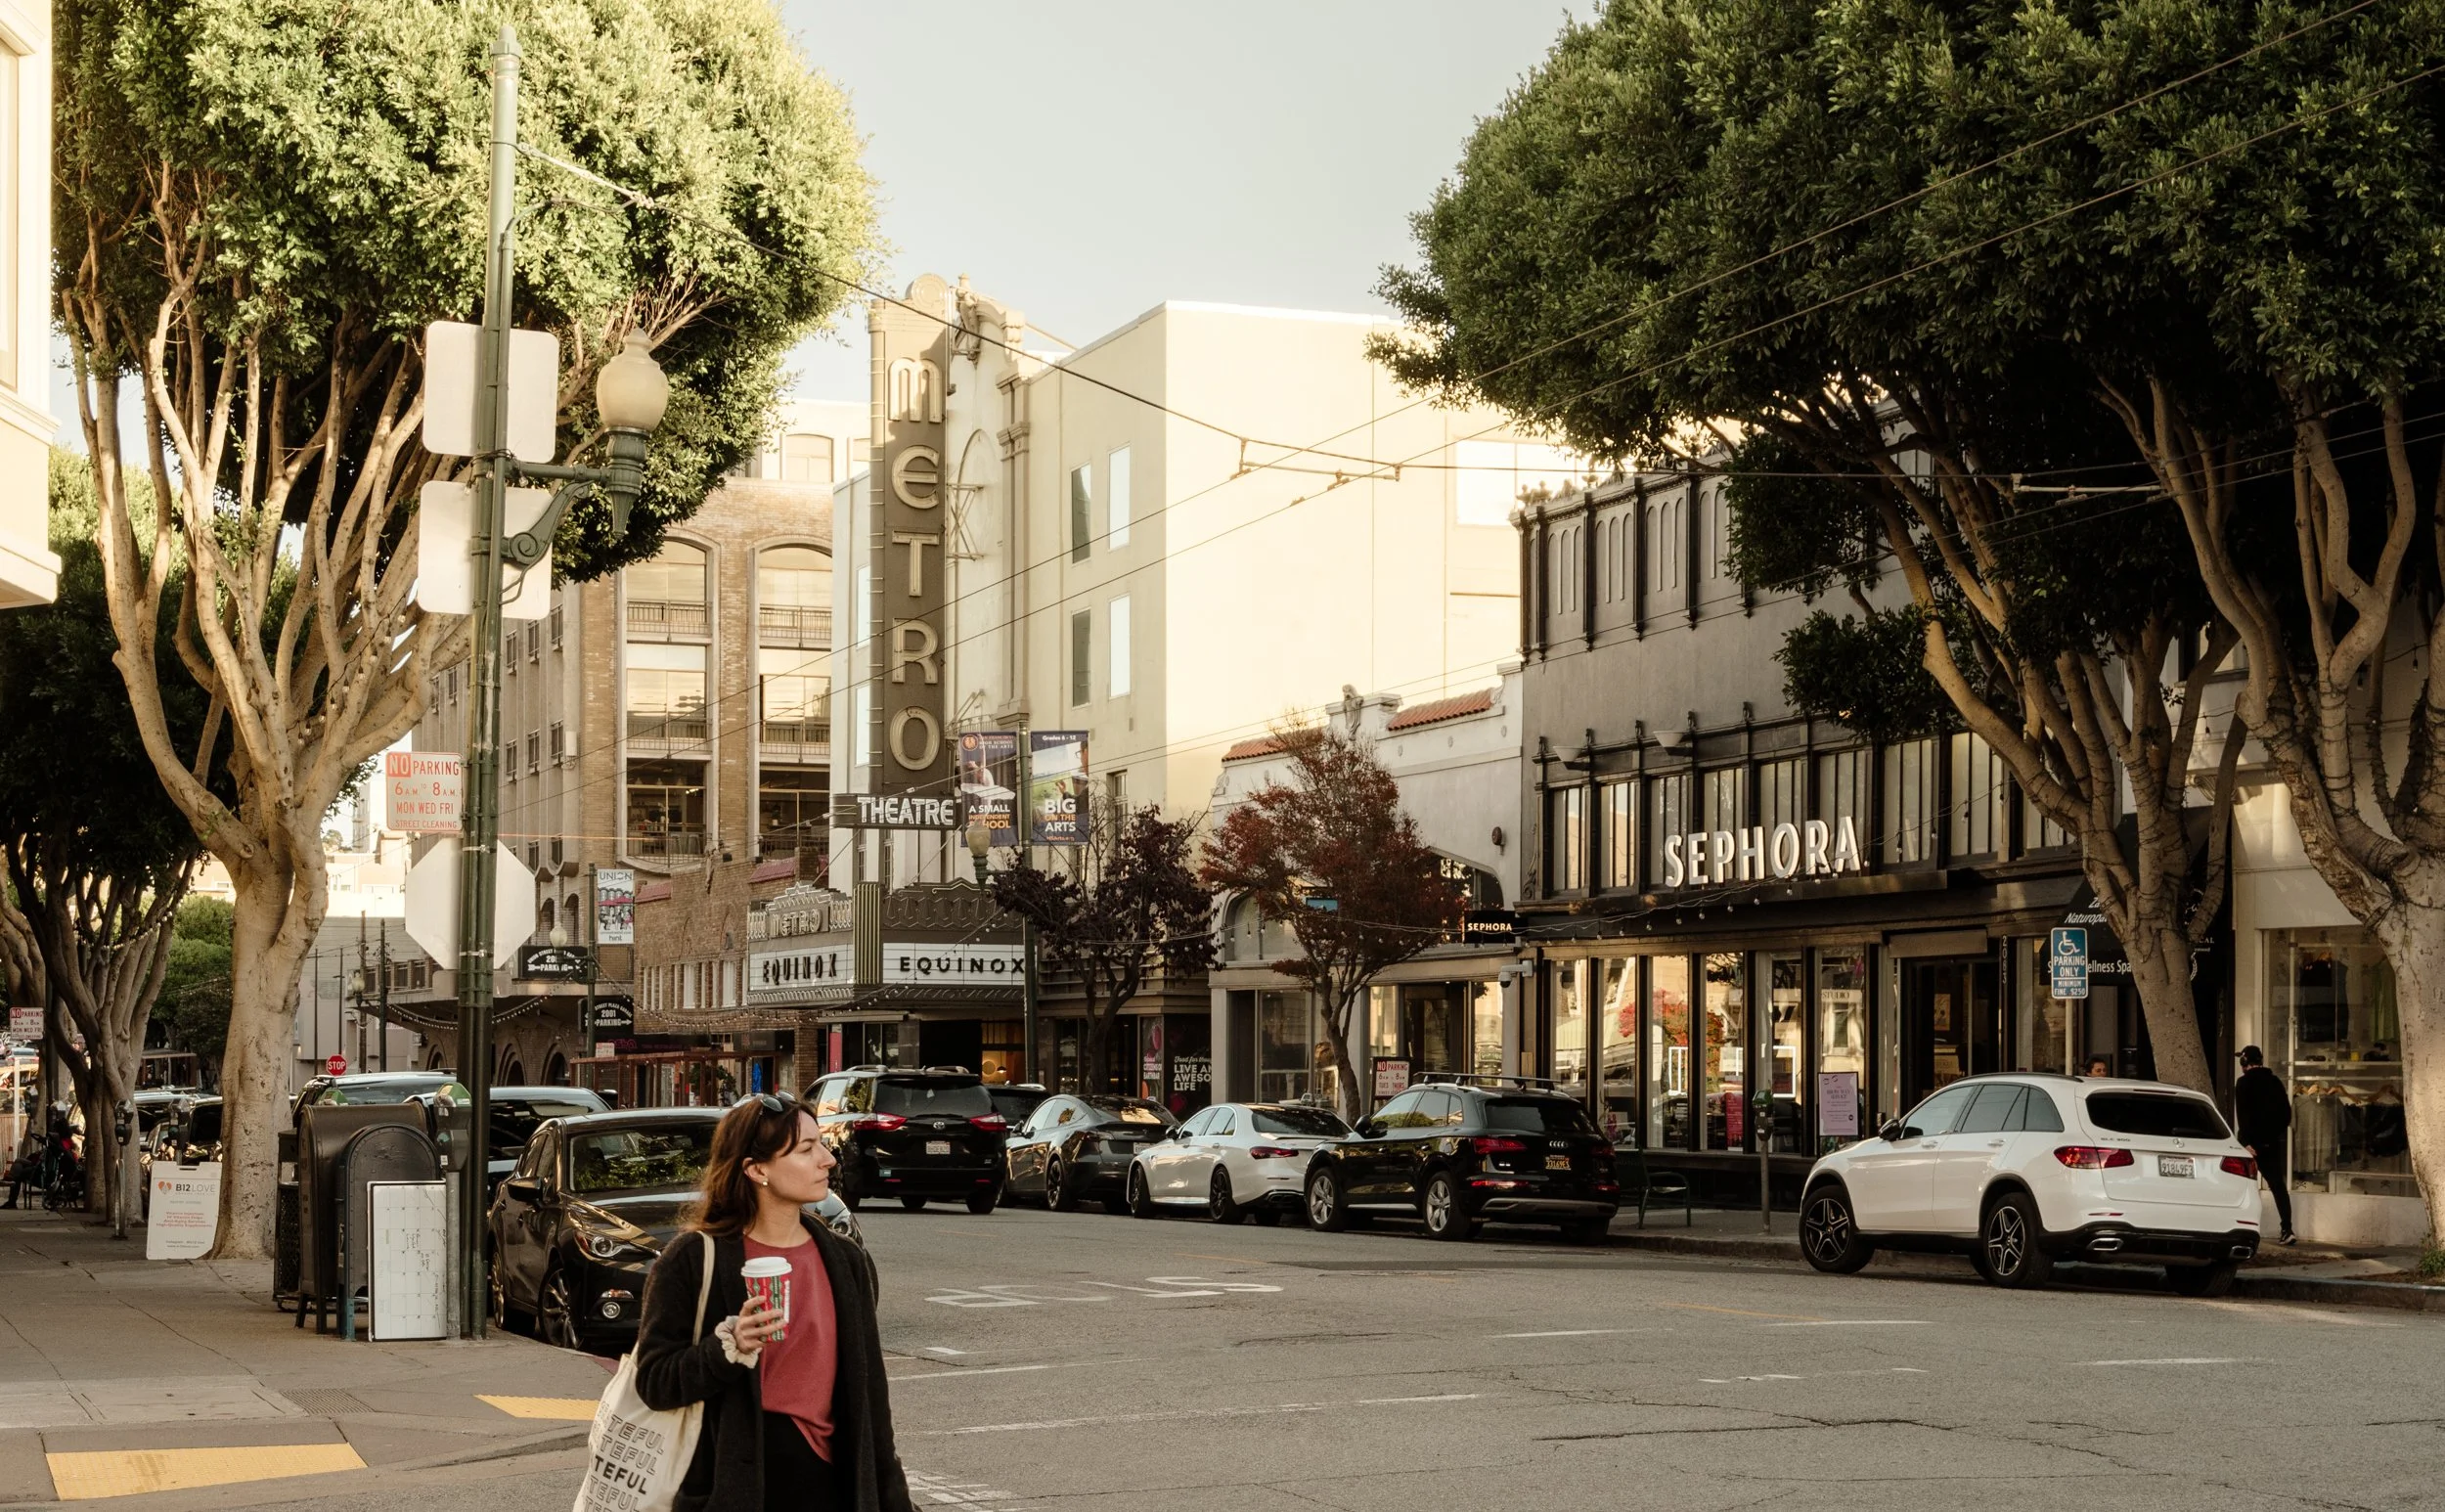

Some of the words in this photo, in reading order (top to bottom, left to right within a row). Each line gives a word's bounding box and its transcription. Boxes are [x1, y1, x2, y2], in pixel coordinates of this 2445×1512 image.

[389, 754, 410, 775] NO
[413, 761, 460, 776] PARKING
[396, 802, 415, 814] MON
[419, 802, 436, 815] WED
[439, 803, 454, 814] FRI
[858, 796, 955, 825] THEATRE
[978, 804, 1011, 813] SMALL
[1045, 798, 1077, 814] BIG
[1045, 822, 1077, 832] ARTS
[1665, 816, 1861, 887] SEPHORA
[600, 871, 633, 880] UNION
[770, 909, 822, 936] METRO
[1467, 922, 1512, 931] SEPHORA
[900, 956, 1025, 975] EQUINOX
[2054, 956, 2085, 966] PARKING
[763, 954, 837, 986] EQUINOX
[2060, 967, 2079, 977] ONLY
[2088, 959, 2114, 973] ellness
[2116, 959, 2132, 975] Spa
[11, 1008, 21, 1017] NO
[600, 1009, 616, 1018] 2001
[596, 1018, 622, 1027] PARKING
[328, 1061, 345, 1070] STOP
[1174, 1064, 1197, 1073] LIVE
[1377, 1061, 1386, 1071] NO
[1174, 1073, 1212, 1083] AWESO
[1174, 1082, 1196, 1090] LIFE
[595, 1454, 648, 1495] TEFUL
